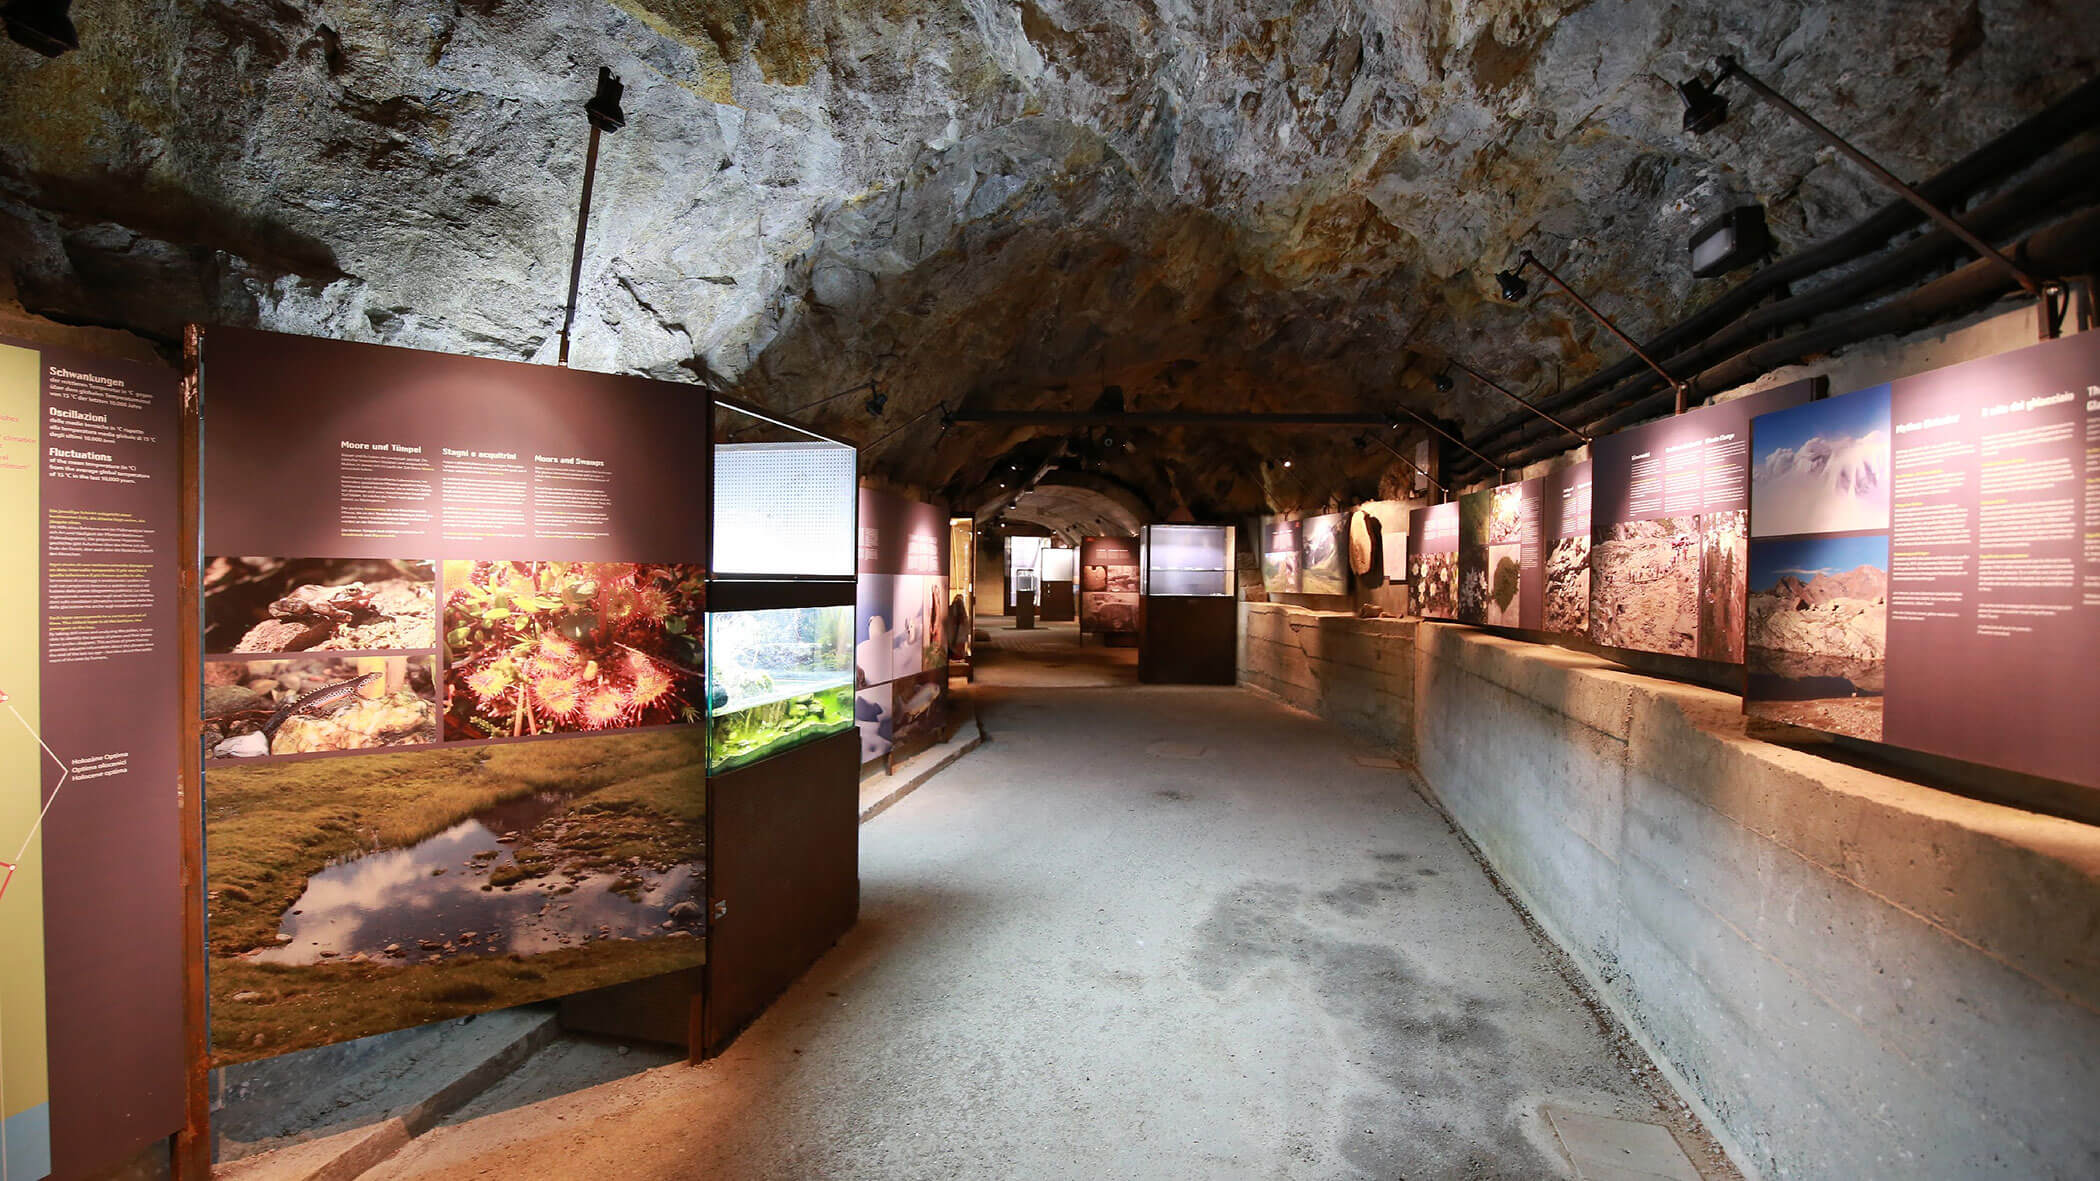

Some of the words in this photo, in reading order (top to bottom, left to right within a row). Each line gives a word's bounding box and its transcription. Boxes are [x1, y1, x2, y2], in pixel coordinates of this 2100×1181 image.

[50, 366, 125, 387] Schwankungen
[50, 406, 107, 423] Oscillazioni
[341, 440, 370, 450] Moore
[372, 443, 389, 451] und
[391, 443, 422, 454] Tümpel
[442, 447, 469, 458] Stagni
[478, 450, 517, 460] acquitrini
[49, 447, 112, 462] Fluctuations
[534, 454, 559, 464] Moors
[560, 455, 574, 465] and
